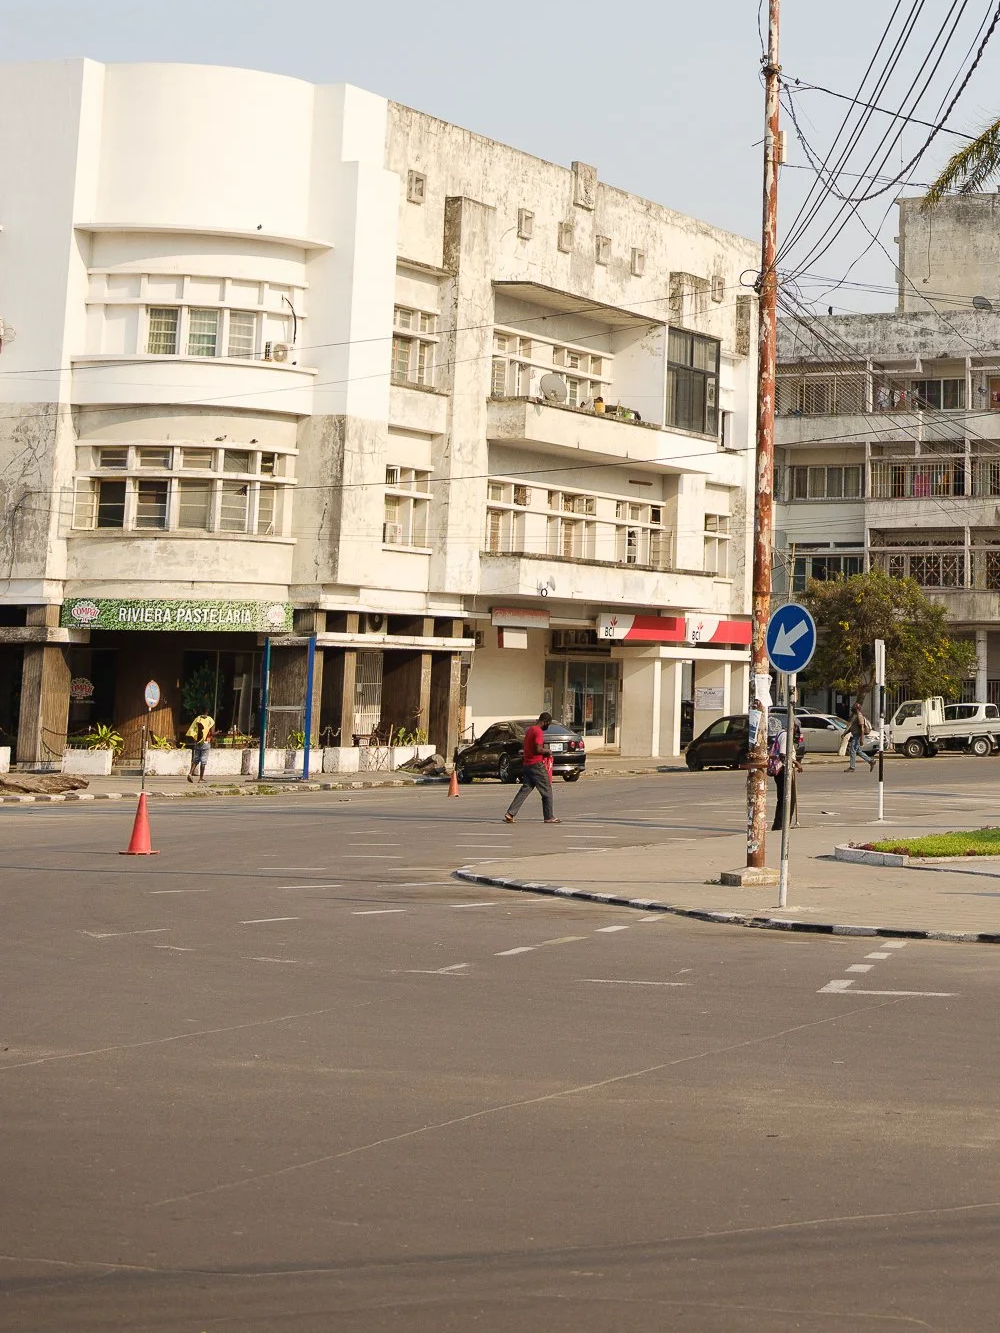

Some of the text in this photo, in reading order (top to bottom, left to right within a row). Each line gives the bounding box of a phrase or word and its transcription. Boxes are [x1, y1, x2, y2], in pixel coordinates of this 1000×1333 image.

[118, 607, 172, 622] RIVIERA
[175, 608, 252, 623] PASTELARIA
[604, 626, 615, 637] BCI
[691, 630, 701, 640] BCI
